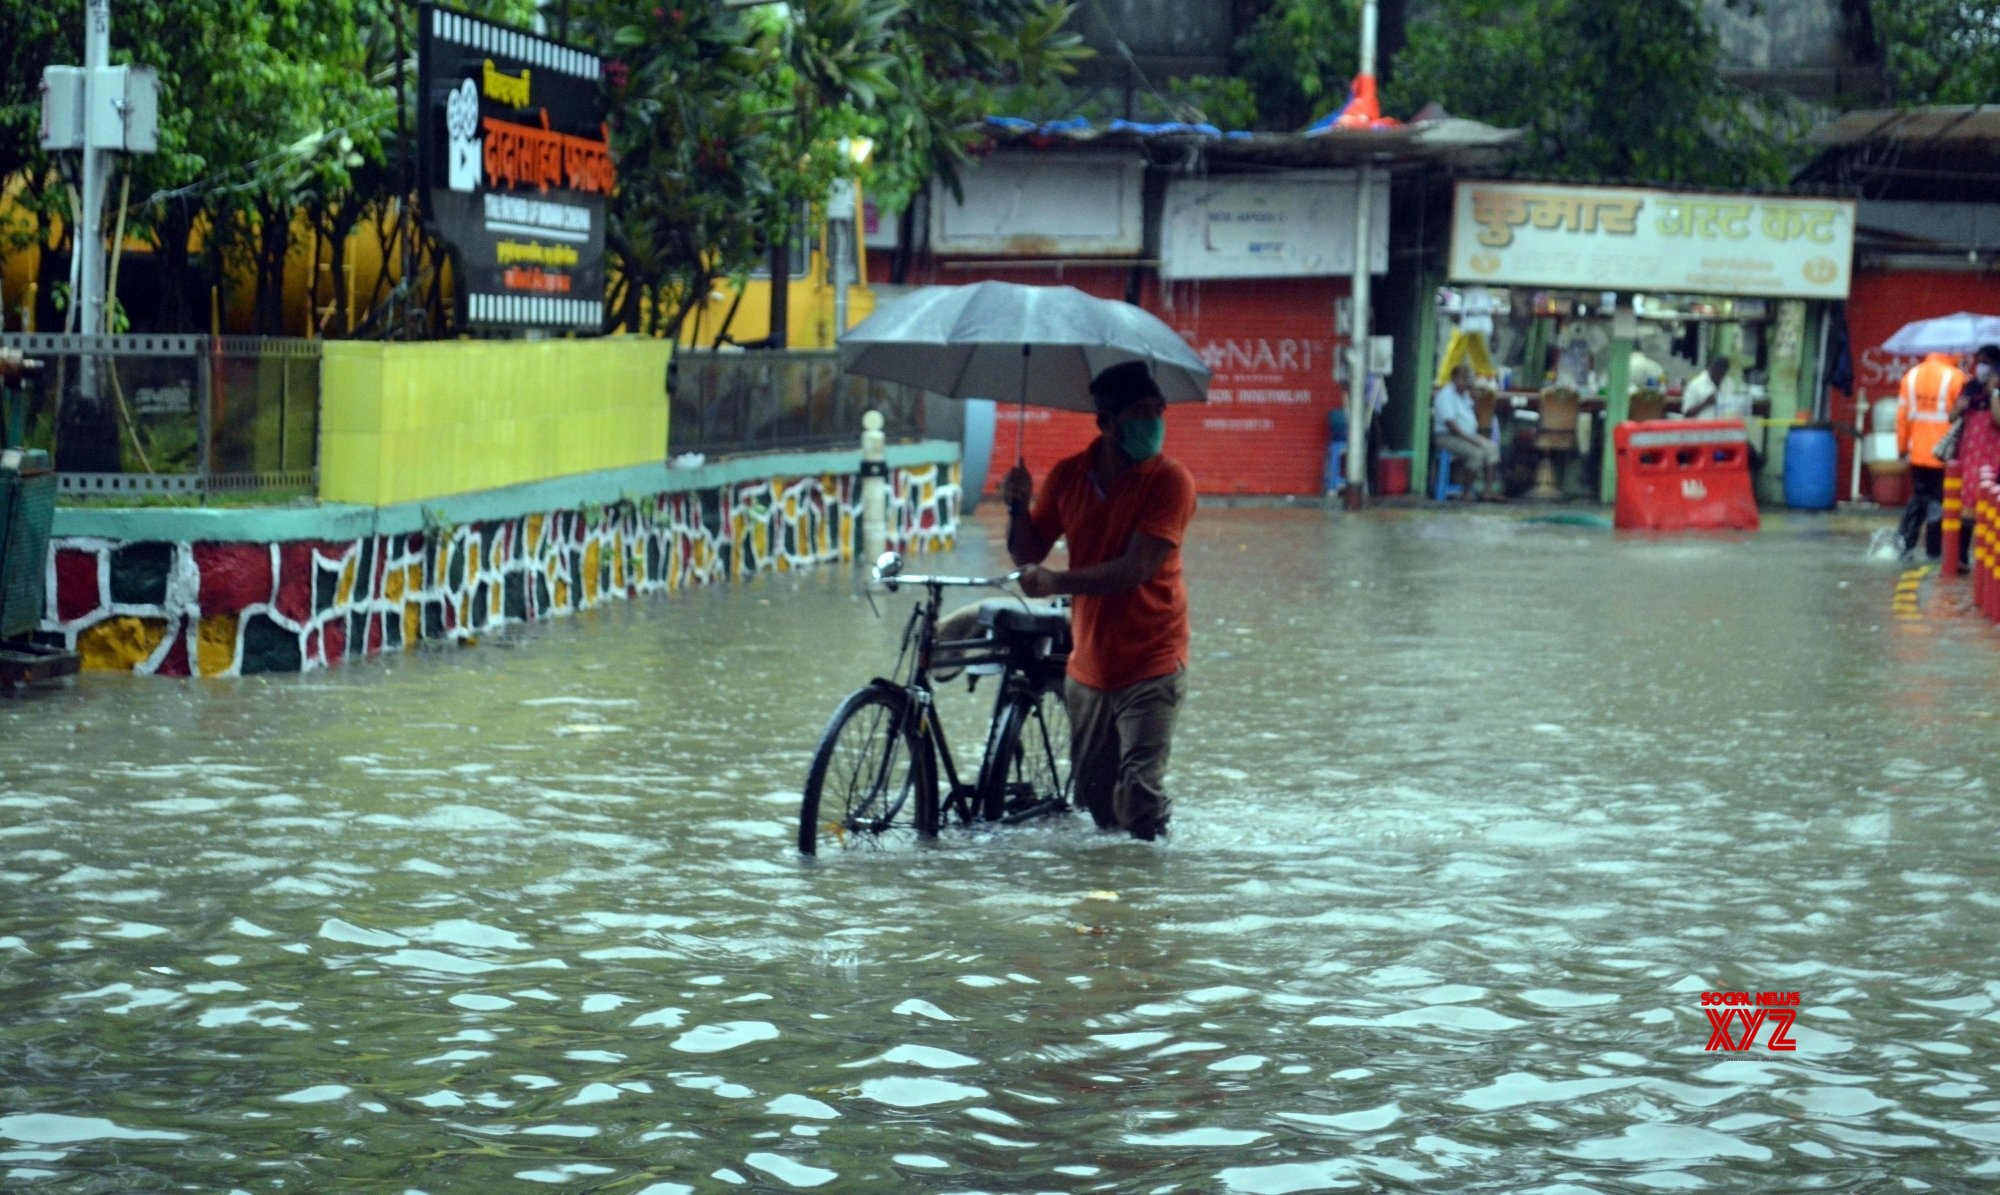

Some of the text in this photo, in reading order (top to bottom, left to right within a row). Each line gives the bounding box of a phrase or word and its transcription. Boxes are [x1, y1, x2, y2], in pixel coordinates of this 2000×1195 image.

[1473, 190, 1835, 247] कुमार जस्ट कट
